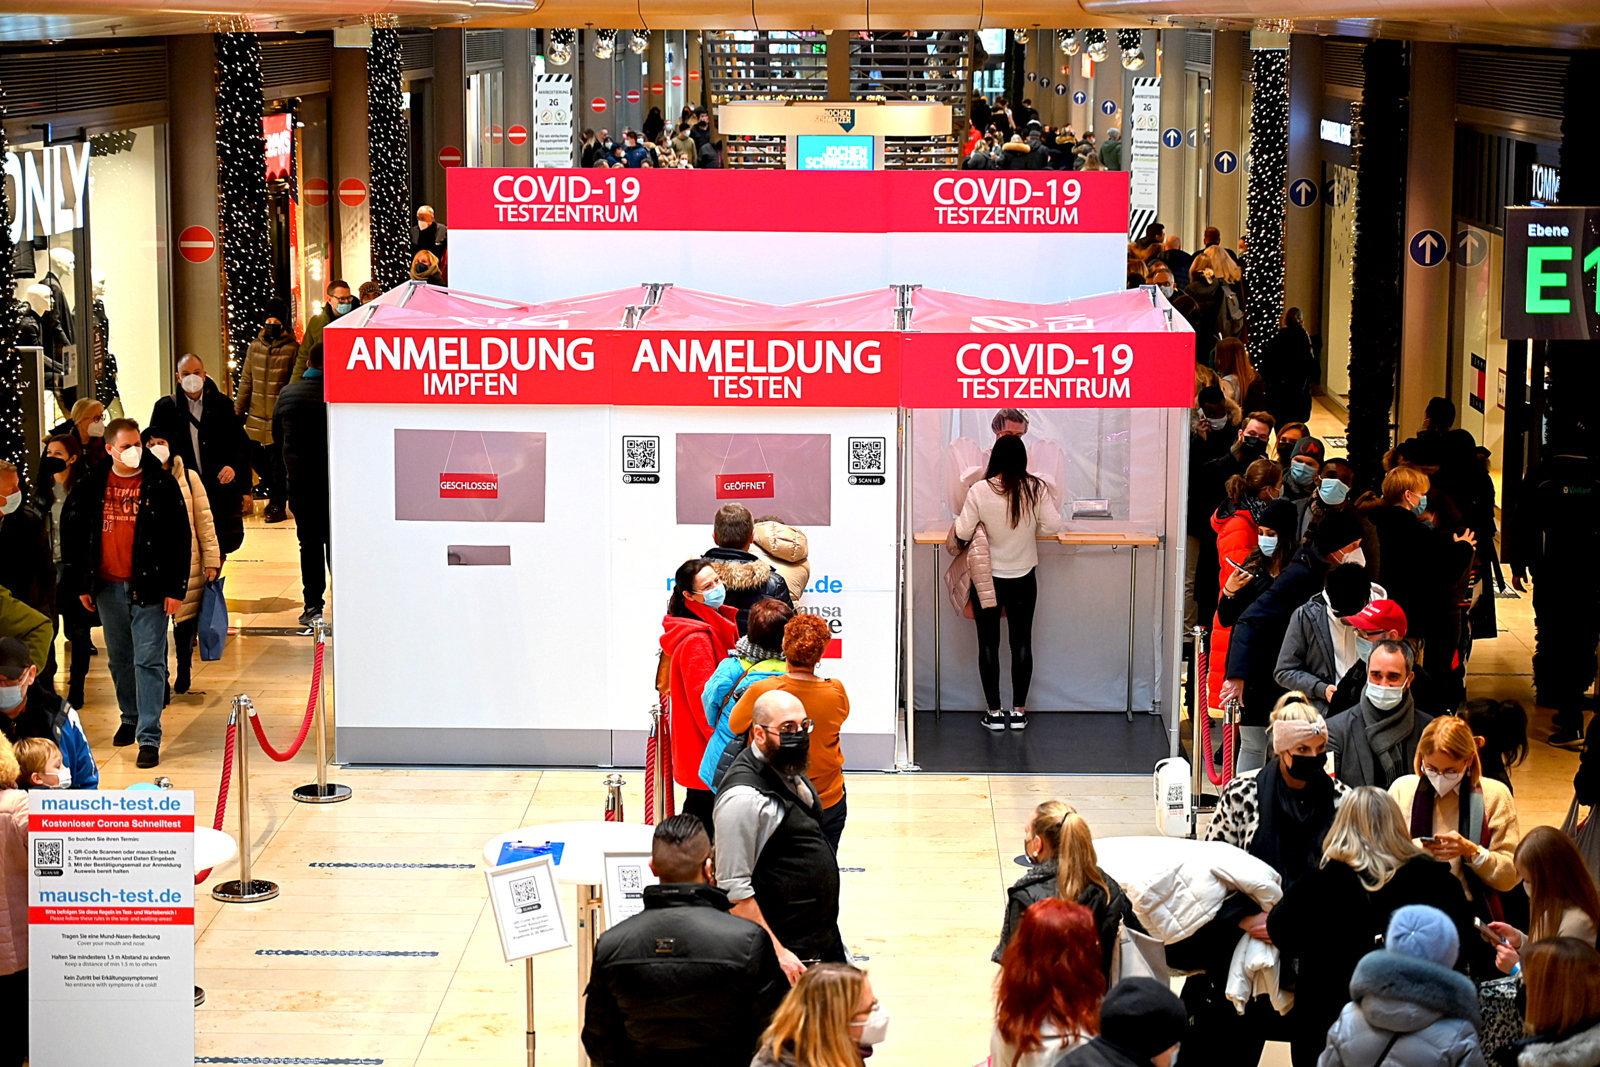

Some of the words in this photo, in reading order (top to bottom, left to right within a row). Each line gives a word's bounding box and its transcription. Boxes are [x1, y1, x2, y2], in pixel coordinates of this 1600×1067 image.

[1143, 103, 1152, 111] 2G
[493, 175, 641, 204] COVID-19
[933, 177, 1081, 206] COVID-19
[1531, 163, 1560, 204] TOMM
[494, 204, 639, 223] TESTZENTRUM
[934, 206, 1080, 225] TESTZENTRUM
[1527, 224, 1570, 238] Ebene
[346, 336, 595, 371] ANMELDUNG
[631, 338, 881, 374] ANMELDUNG
[955, 343, 1134, 376] COVID-19
[422, 372, 519, 396] IMPFEN
[708, 376, 803, 399] TESTEN
[957, 377, 1132, 399] TESTZENTRUM
[440, 481, 498, 492] GESCHLOSSEN
[724, 480, 766, 492] GEÖFFNET
[42, 796, 181, 811] mausch-test.de
[42, 819, 95, 828] Kostenloser
[97, 819, 129, 828] Corona
[131, 819, 182, 828] Schnelltest
[40, 888, 182, 903] mausch-test.de
